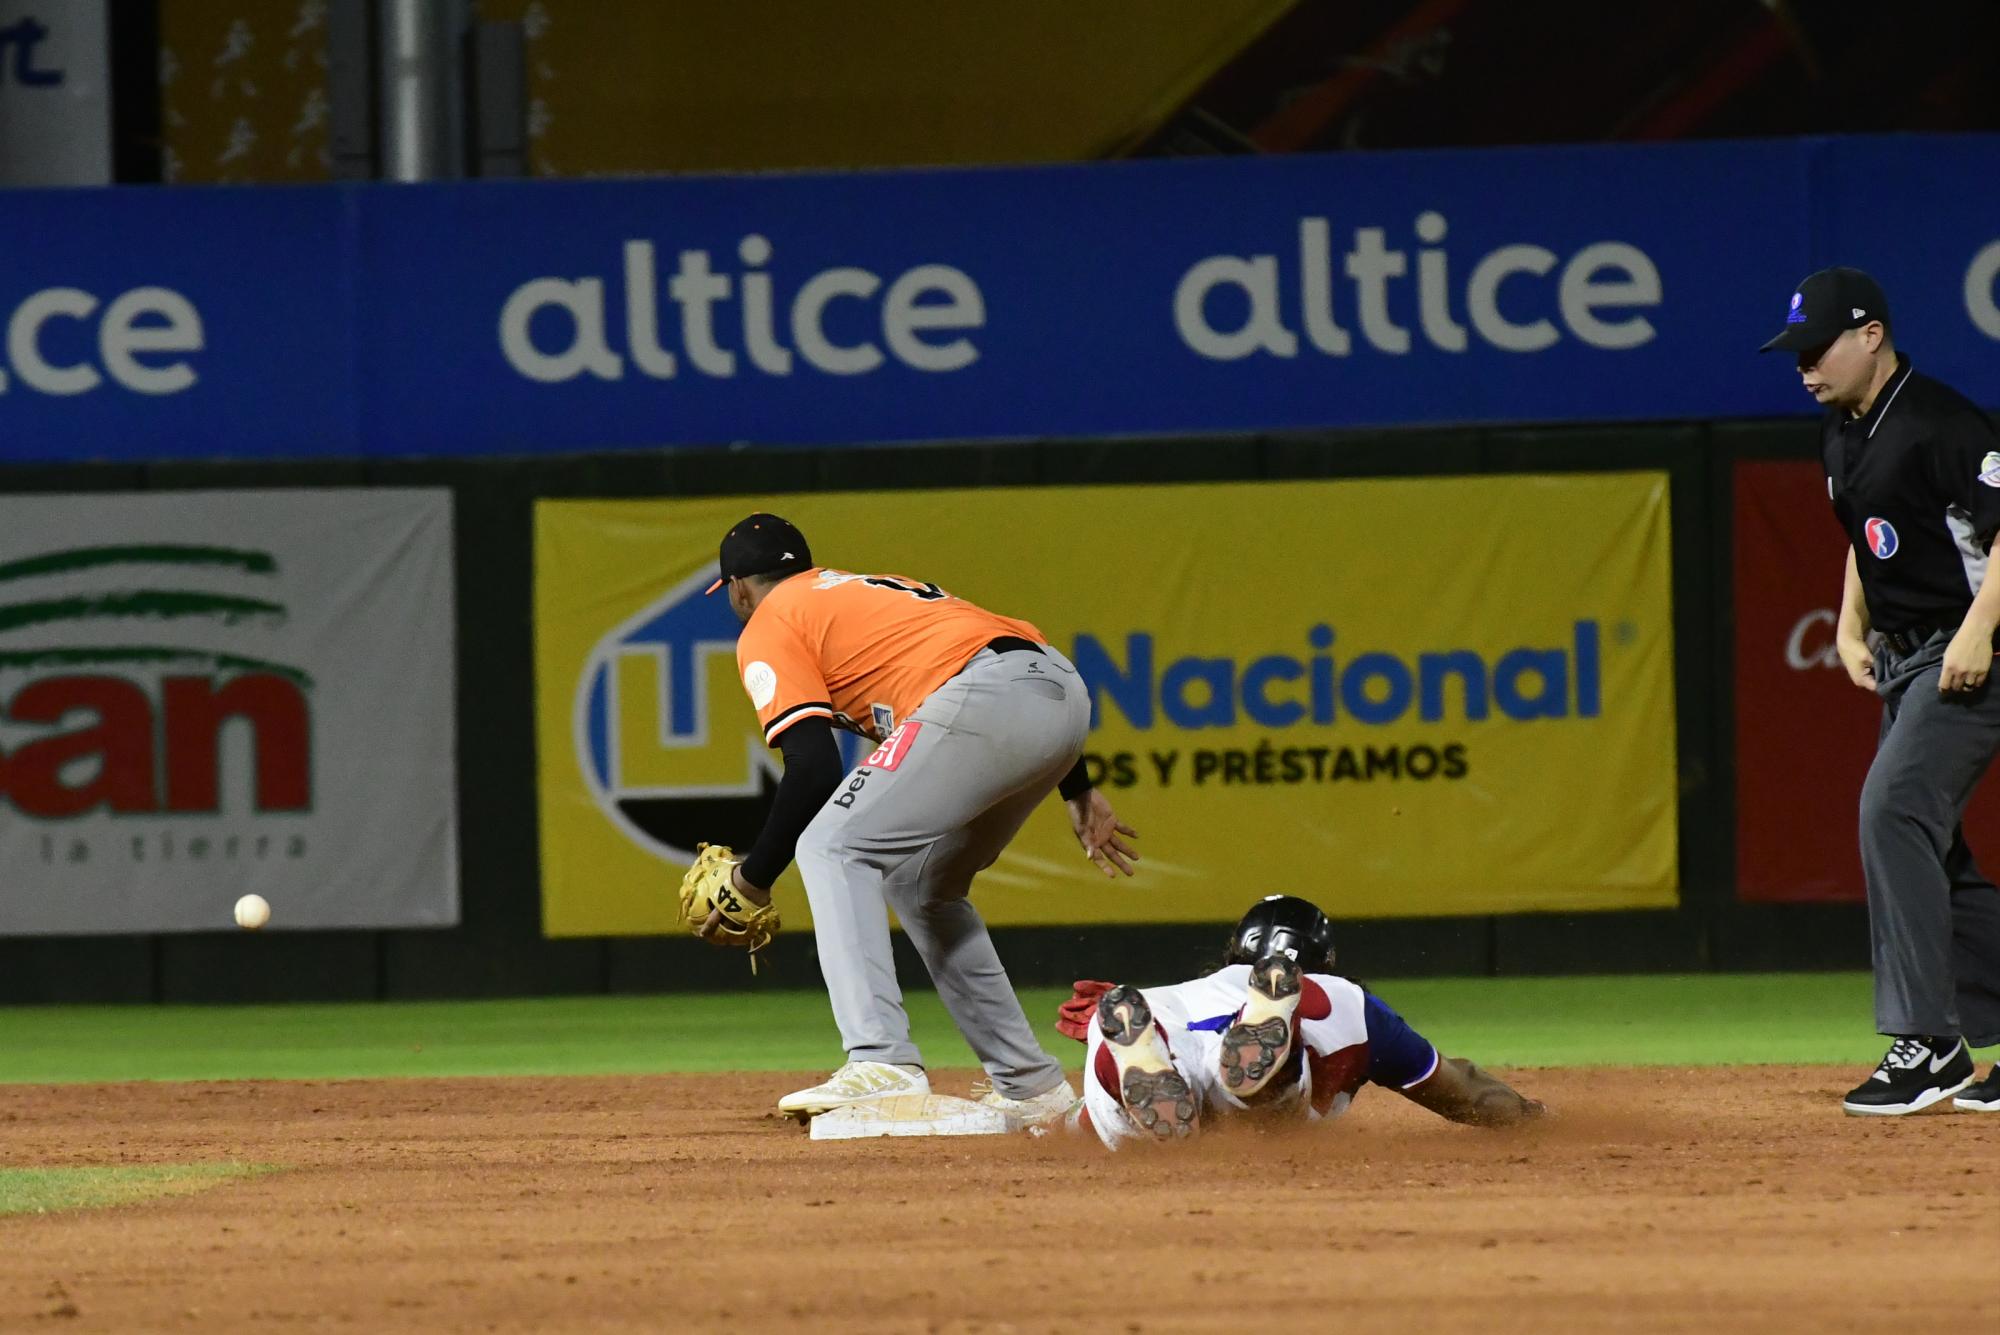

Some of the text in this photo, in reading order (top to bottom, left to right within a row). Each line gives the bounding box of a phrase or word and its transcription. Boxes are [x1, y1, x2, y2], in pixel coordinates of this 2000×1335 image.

[0, 17, 65, 87] t
[0, 287, 204, 395] ce
[500, 236, 984, 382] altice
[1174, 213, 1661, 360] altice
[1072, 620, 1602, 731] Nacional
[1150, 750, 1180, 787] Y
[1192, 740, 1470, 785] PRÉSTAMOS
